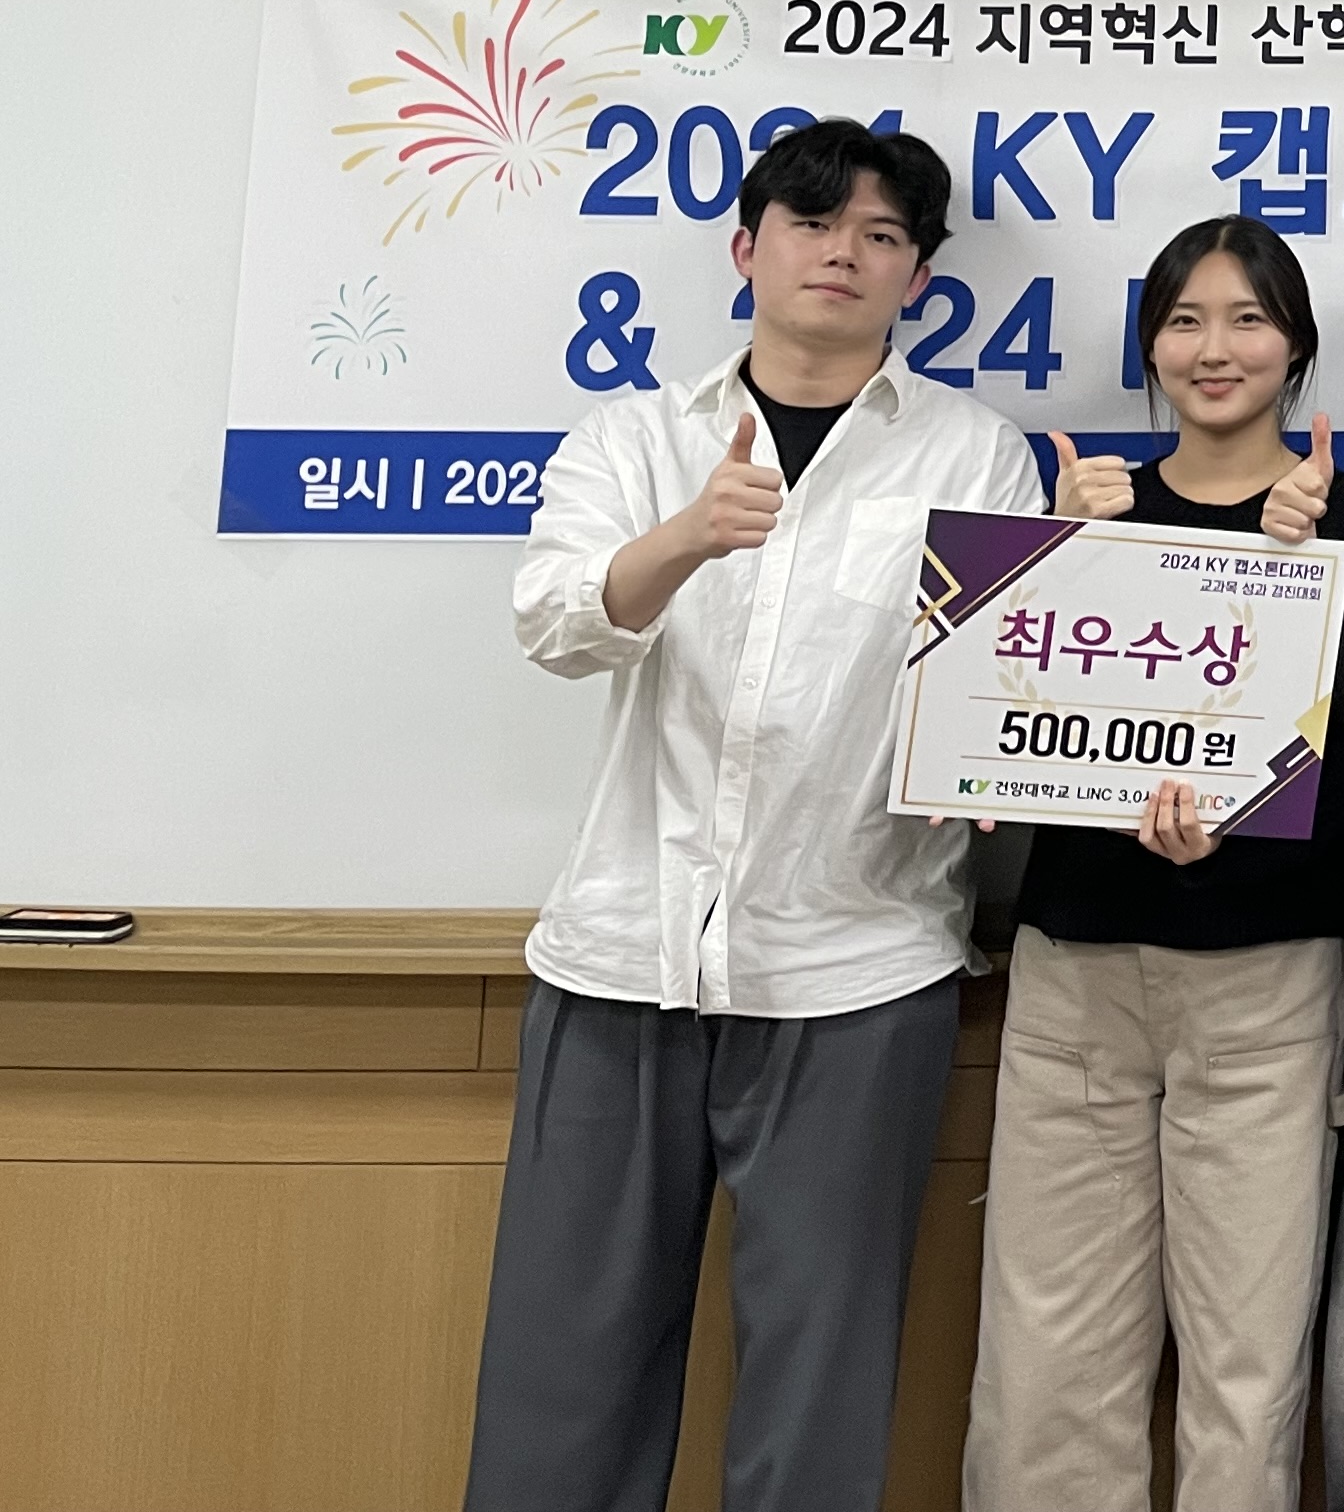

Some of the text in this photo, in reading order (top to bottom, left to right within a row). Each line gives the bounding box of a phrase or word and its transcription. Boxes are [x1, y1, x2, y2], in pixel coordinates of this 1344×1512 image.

[643, 14, 730, 56] KY
[784, 0, 950, 56] 2024
[976, 3, 1219, 65] 지역혁신
[579, 104, 905, 222] 20
[972, 111, 1155, 221] KY
[565, 271, 661, 392] &
[299, 457, 389, 510] 일시
[445, 460, 546, 506] 202
[1160, 552, 1324, 581] 2024 KY 캡스톤디자인
[994, 607, 1250, 687] 최우수상
[998, 709, 1236, 767] 500,000 원
[995, 780, 1070, 800] 건양대학교
[1077, 786, 1112, 802] LINC
